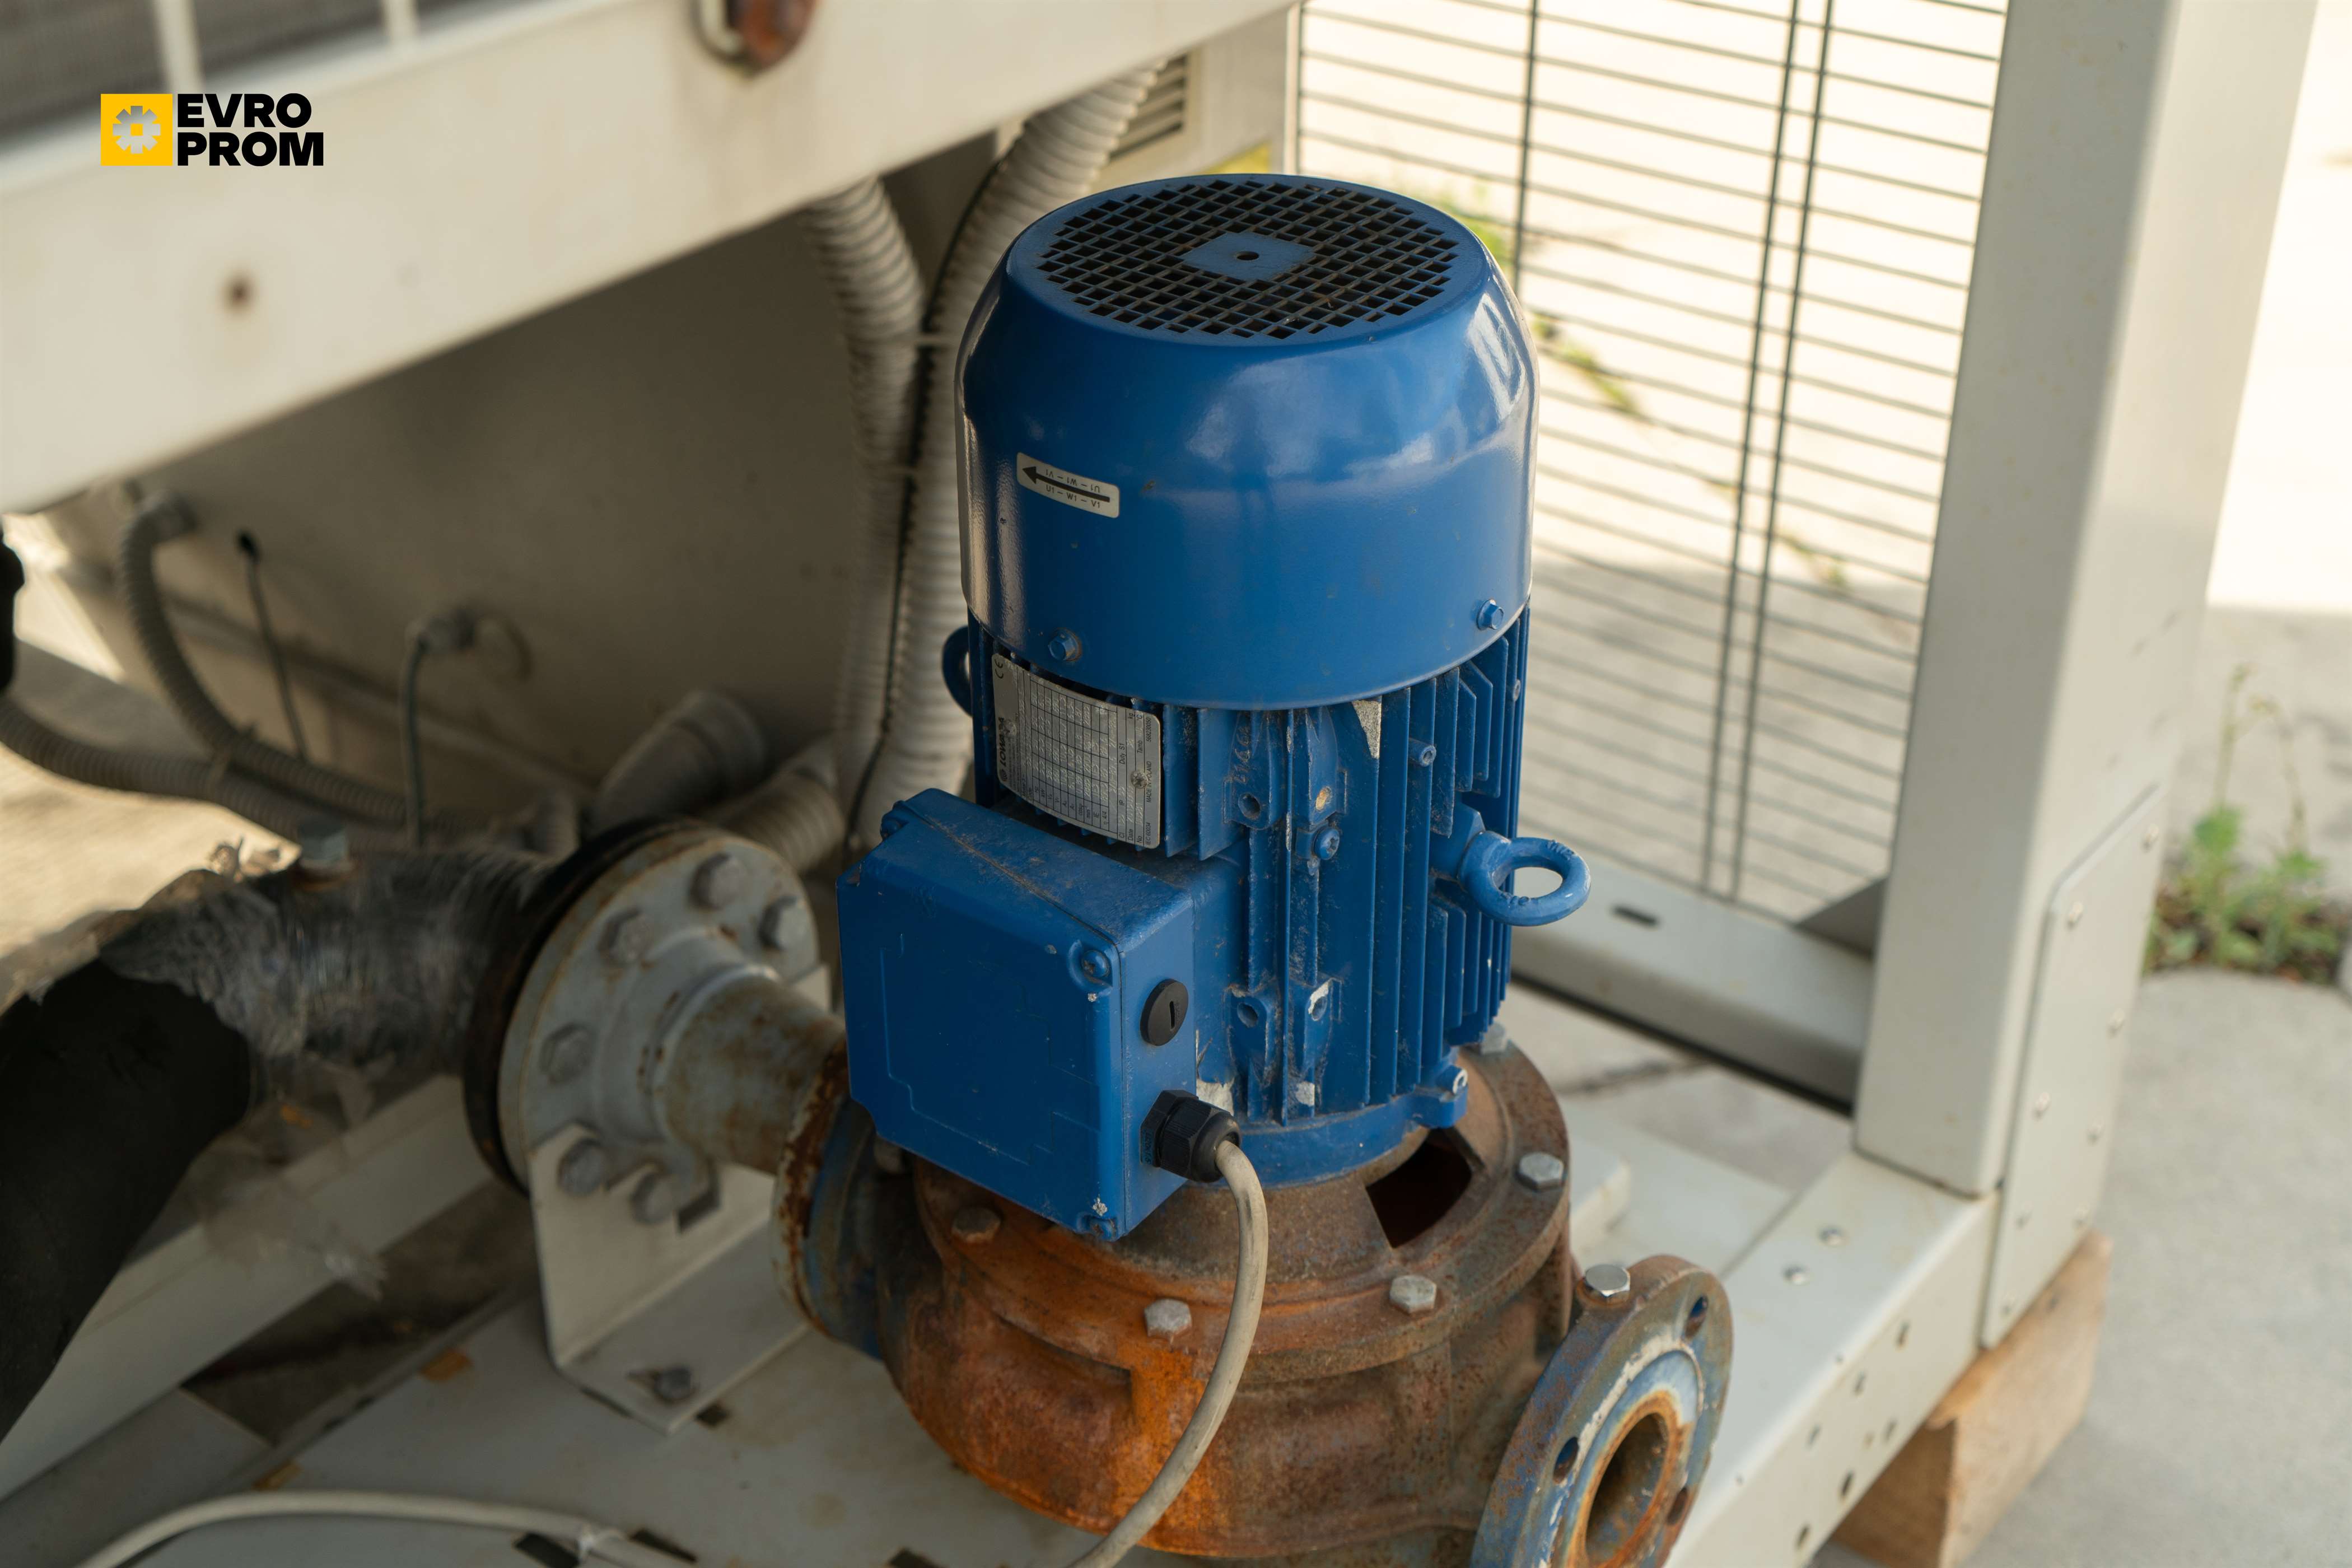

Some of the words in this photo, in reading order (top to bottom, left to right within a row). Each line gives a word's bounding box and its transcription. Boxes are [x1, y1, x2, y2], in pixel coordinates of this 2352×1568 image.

[1046, 469, 1053, 478] V1
[1067, 477, 1077, 486] W1
[1046, 485, 1054, 493] U1
[1067, 493, 1077, 502] W1
[1091, 500, 1100, 508] V1
